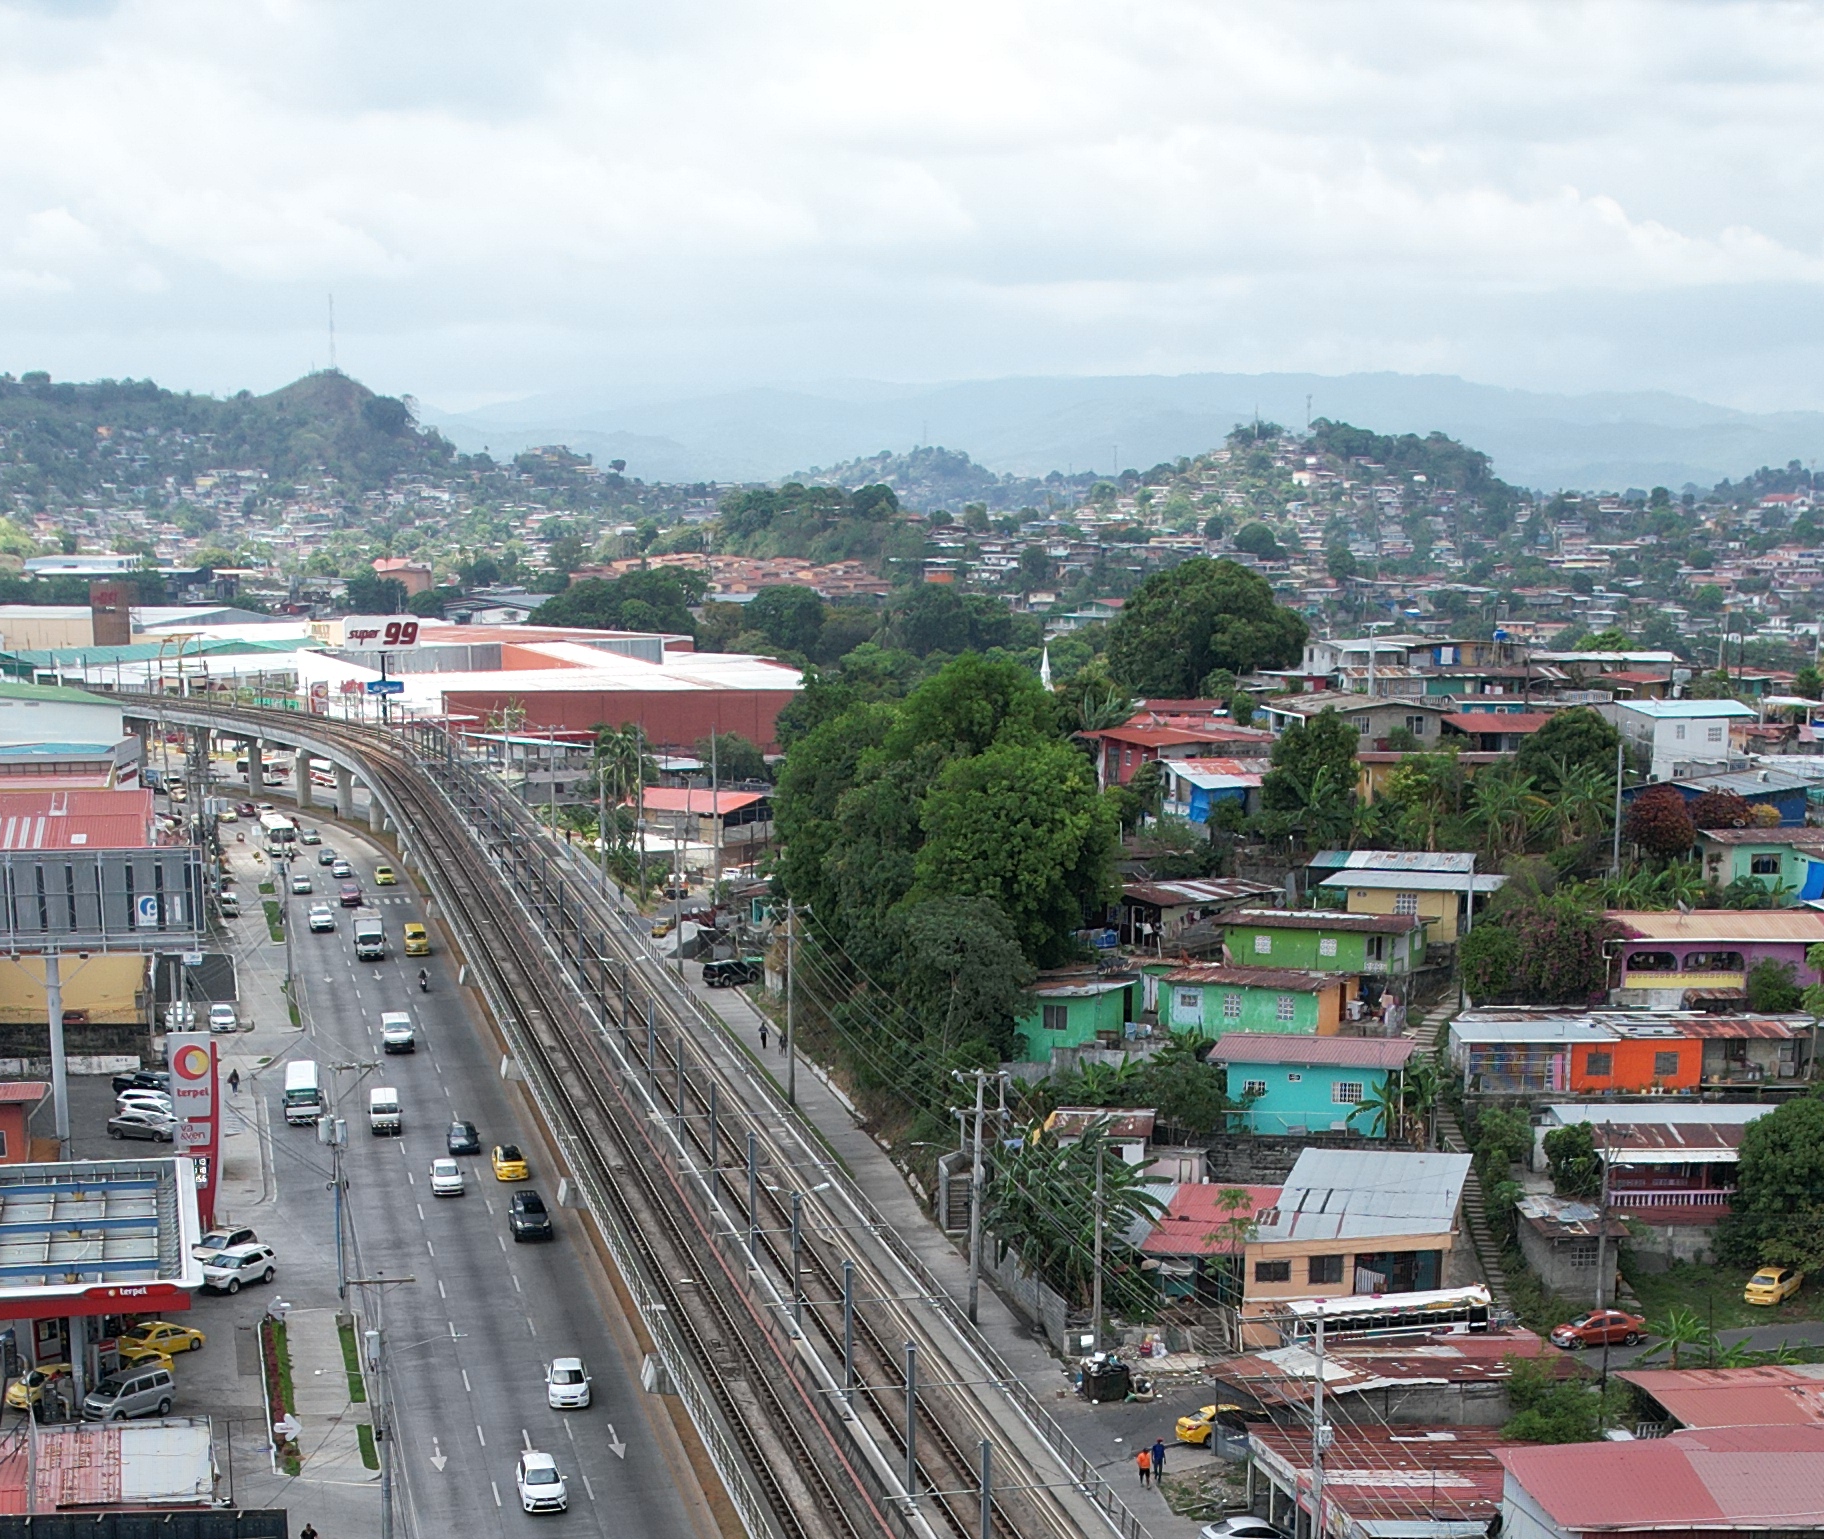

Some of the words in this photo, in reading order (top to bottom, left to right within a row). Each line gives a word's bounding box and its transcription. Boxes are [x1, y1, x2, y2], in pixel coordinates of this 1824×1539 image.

[347, 629, 381, 646] super
[382, 622, 419, 645] 99
[177, 1086, 210, 1099] terpel
[119, 1286, 147, 1297] terpel
